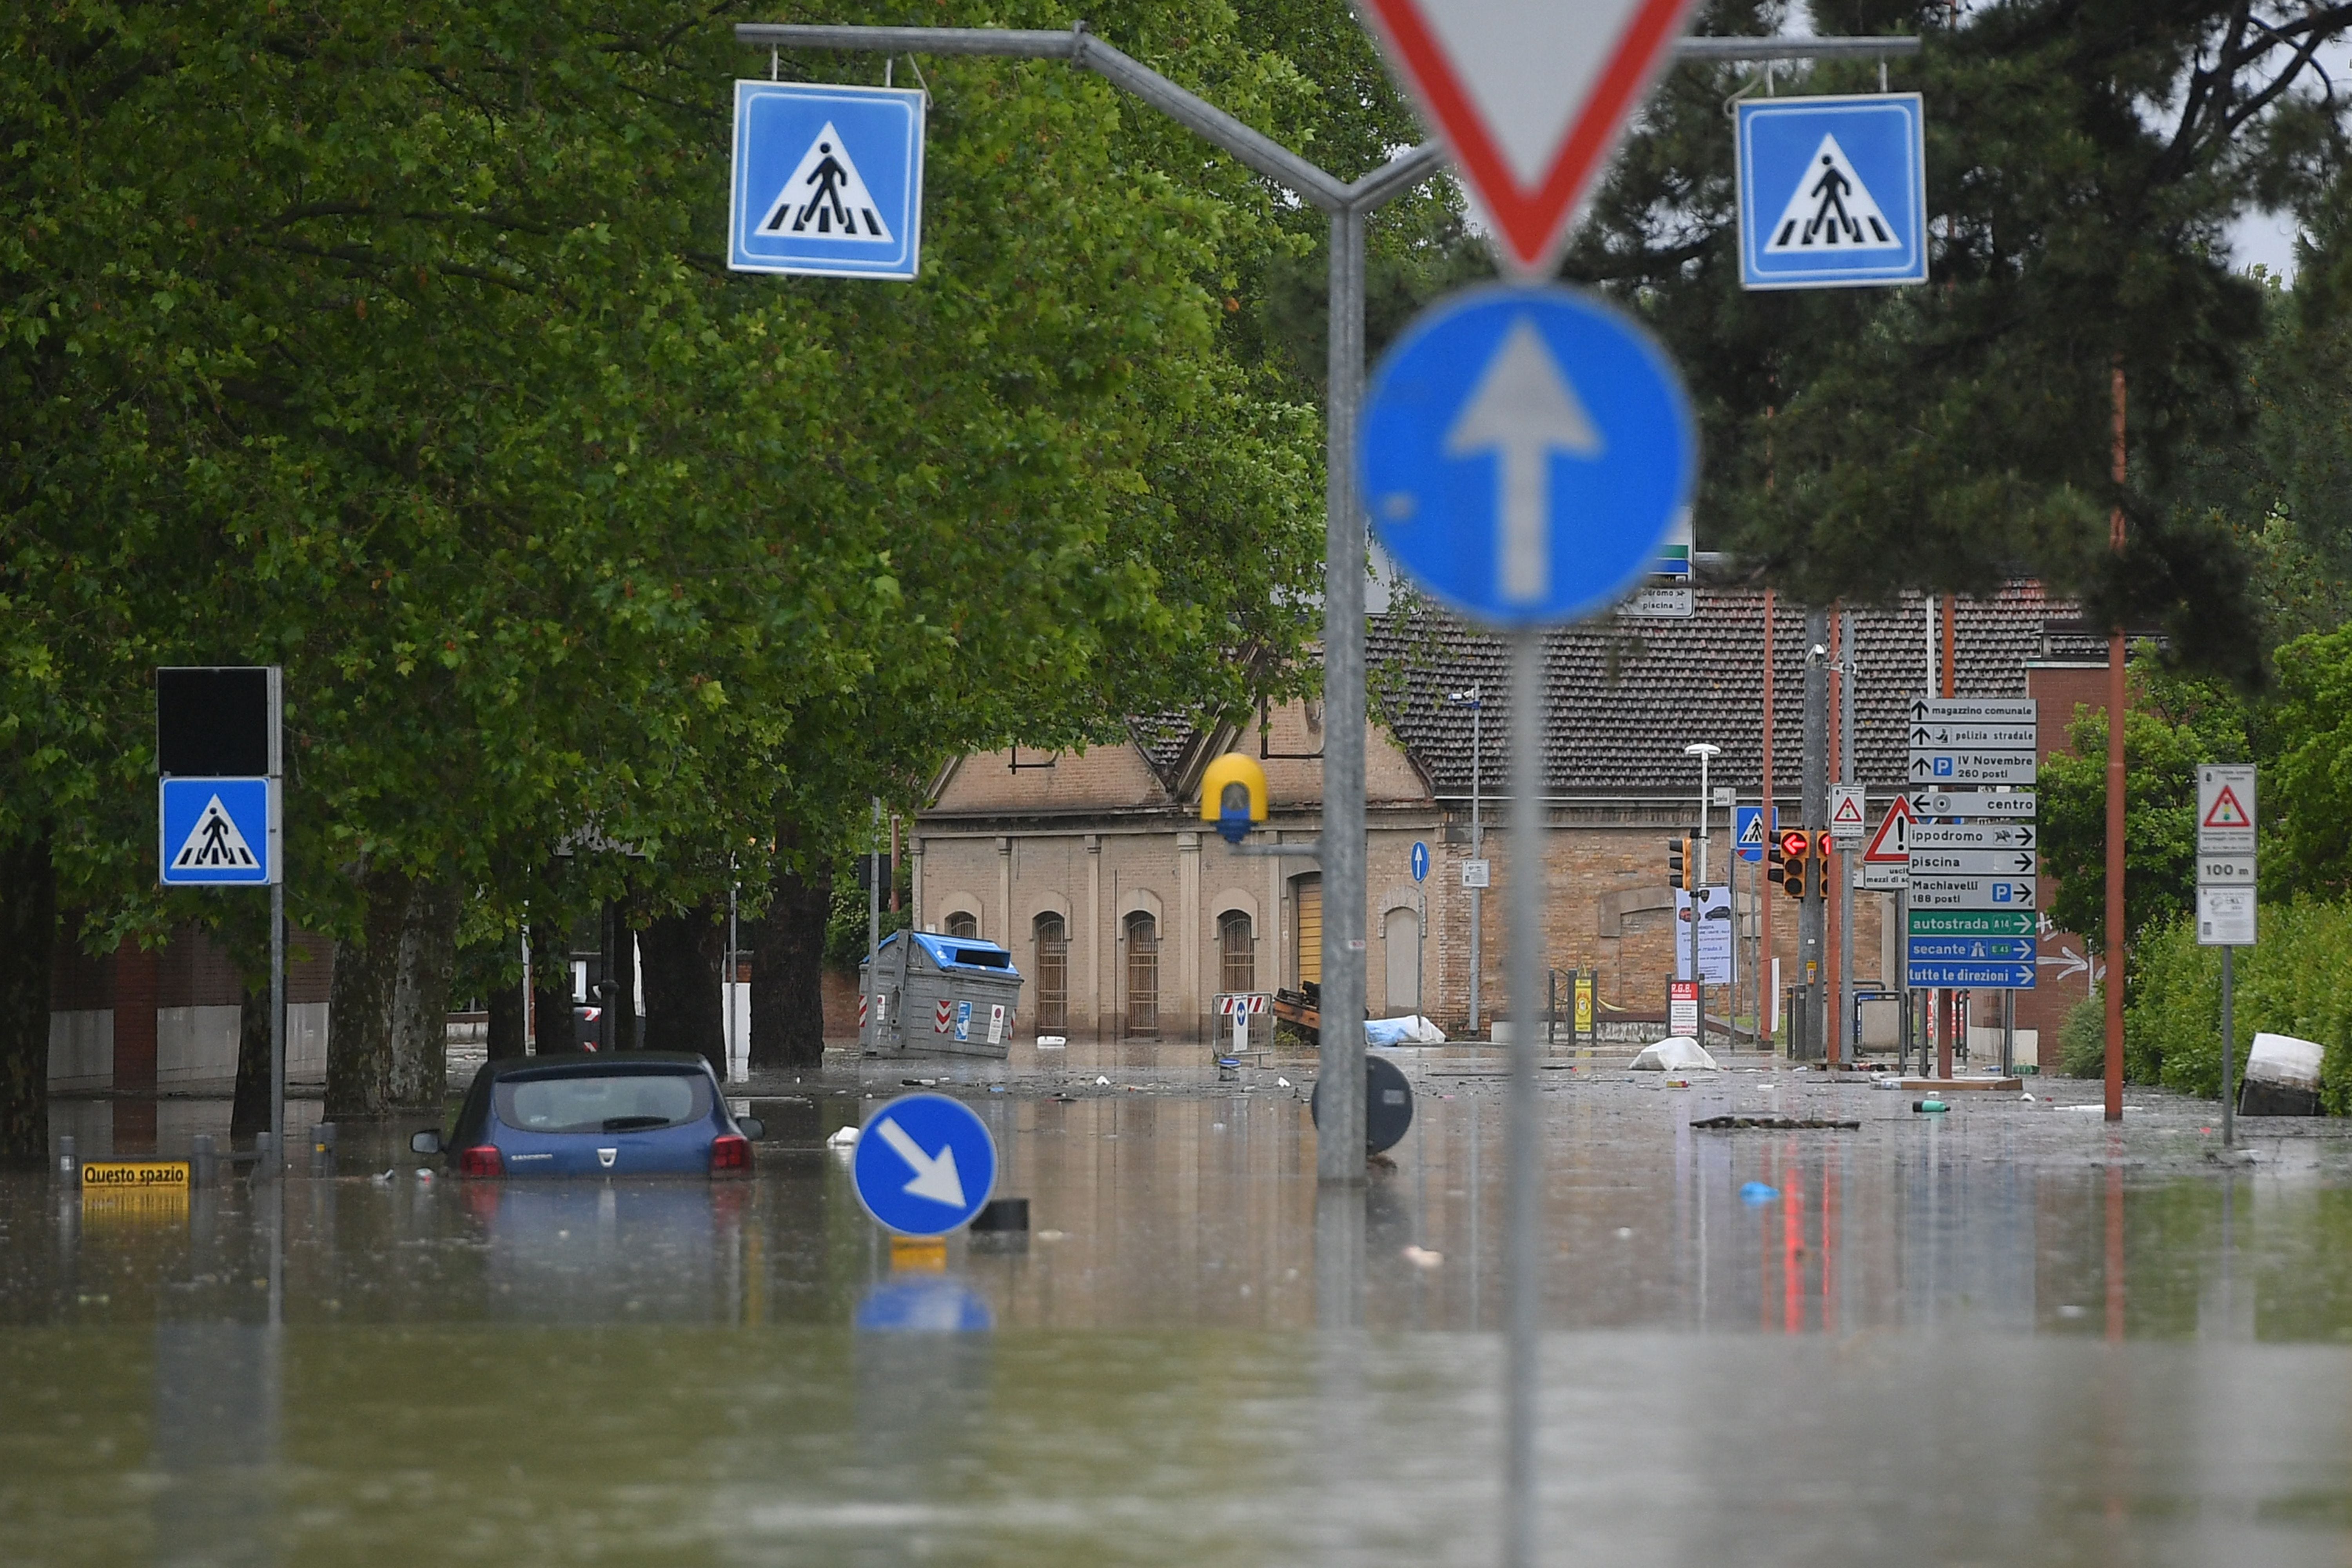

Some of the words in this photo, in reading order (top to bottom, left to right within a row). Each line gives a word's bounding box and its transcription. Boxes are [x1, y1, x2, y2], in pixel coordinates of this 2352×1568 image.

[1932, 707, 1982, 716] magazzino
[1956, 731, 1987, 740] polizia
[1994, 731, 2033, 740] stradale
[1958, 756, 1969, 765] IV
[1974, 756, 2033, 765] Novembre
[1982, 770, 2008, 779] posti
[1987, 800, 2033, 809] centro
[1912, 830, 1983, 842] ippodromo
[1912, 857, 1960, 868] piscina
[2206, 864, 2233, 875] 100
[1913, 881, 1978, 890] Machiavelli
[1935, 895, 1960, 904] posti
[1913, 918, 1989, 929] autostrada
[1913, 944, 1965, 954] secante
[1909, 968, 1939, 981] tutte
[1943, 968, 1955, 981] le
[1957, 969, 2009, 981] direzioni
[1671, 984, 1692, 993] R.G.B.
[85, 1167, 135, 1183] Questo
[140, 1165, 183, 1186] spazio
